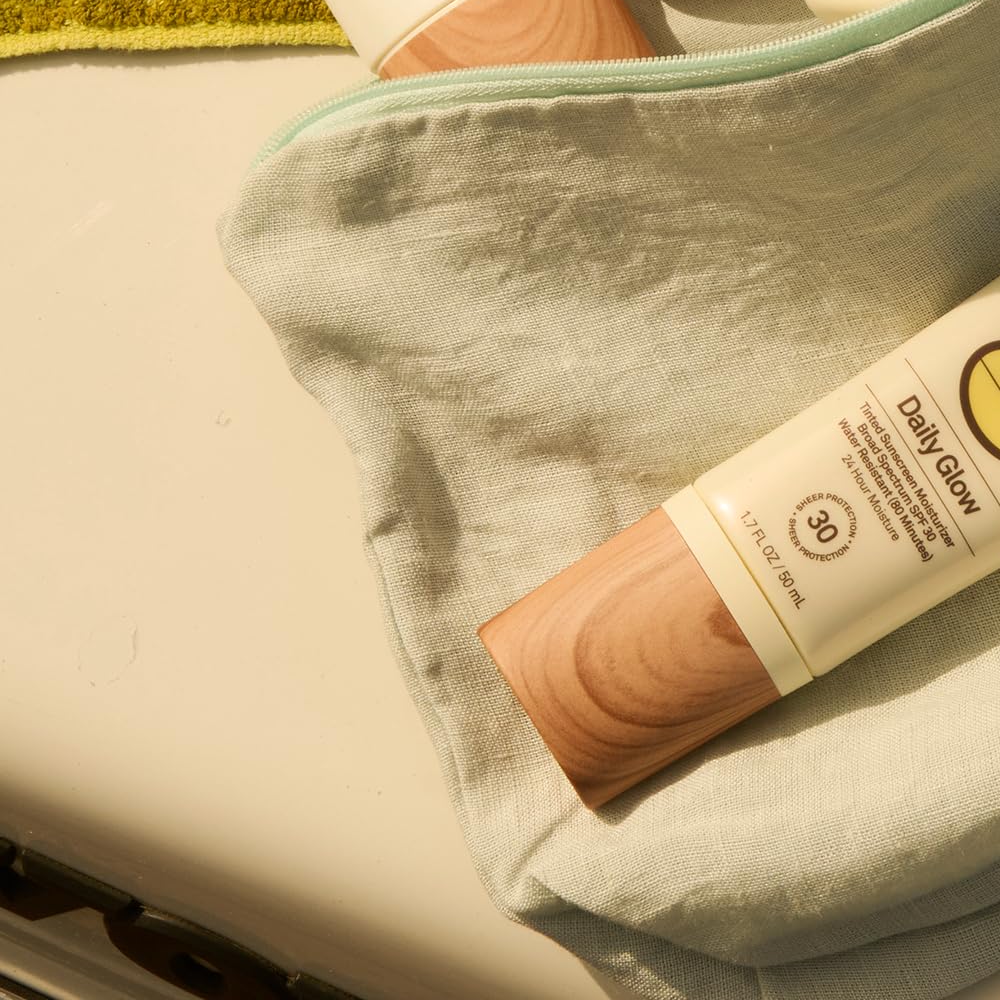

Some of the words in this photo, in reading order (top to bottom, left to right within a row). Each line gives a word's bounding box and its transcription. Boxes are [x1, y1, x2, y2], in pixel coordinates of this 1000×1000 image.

[838, 418, 862, 448] Water
[857, 447, 893, 499] Resistant
[887, 497, 905, 516] (80
[899, 514, 934, 562] Minutes)
[841, 454, 856, 469] 24
[850, 467, 871, 494] Hour
[867, 493, 899, 541] Moisture
[857, 423, 883, 455] Broad
[877, 453, 912, 506] Spectrum
[909, 504, 929, 526] SPF
[922, 526, 937, 542] 30
[860, 401, 886, 435] Tinted
[880, 433, 918, 489] Sunscreen
[914, 488, 955, 548] Moisturizer
[897, 394, 944, 455] Daily
[936, 454, 981, 515] Glow
[740, 510, 758, 527] 1.7
[751, 528, 766, 548] FL
[762, 545, 781, 565] OZ
[778, 570, 795, 588] 50
[788, 588, 806, 610] mL
[788, 518, 801, 548] SHEER
[798, 544, 850, 562] PROTECTION
[795, 493, 824, 512] SHEER
[825, 493, 857, 538] PROTECTION
[807, 510, 838, 543] 30
